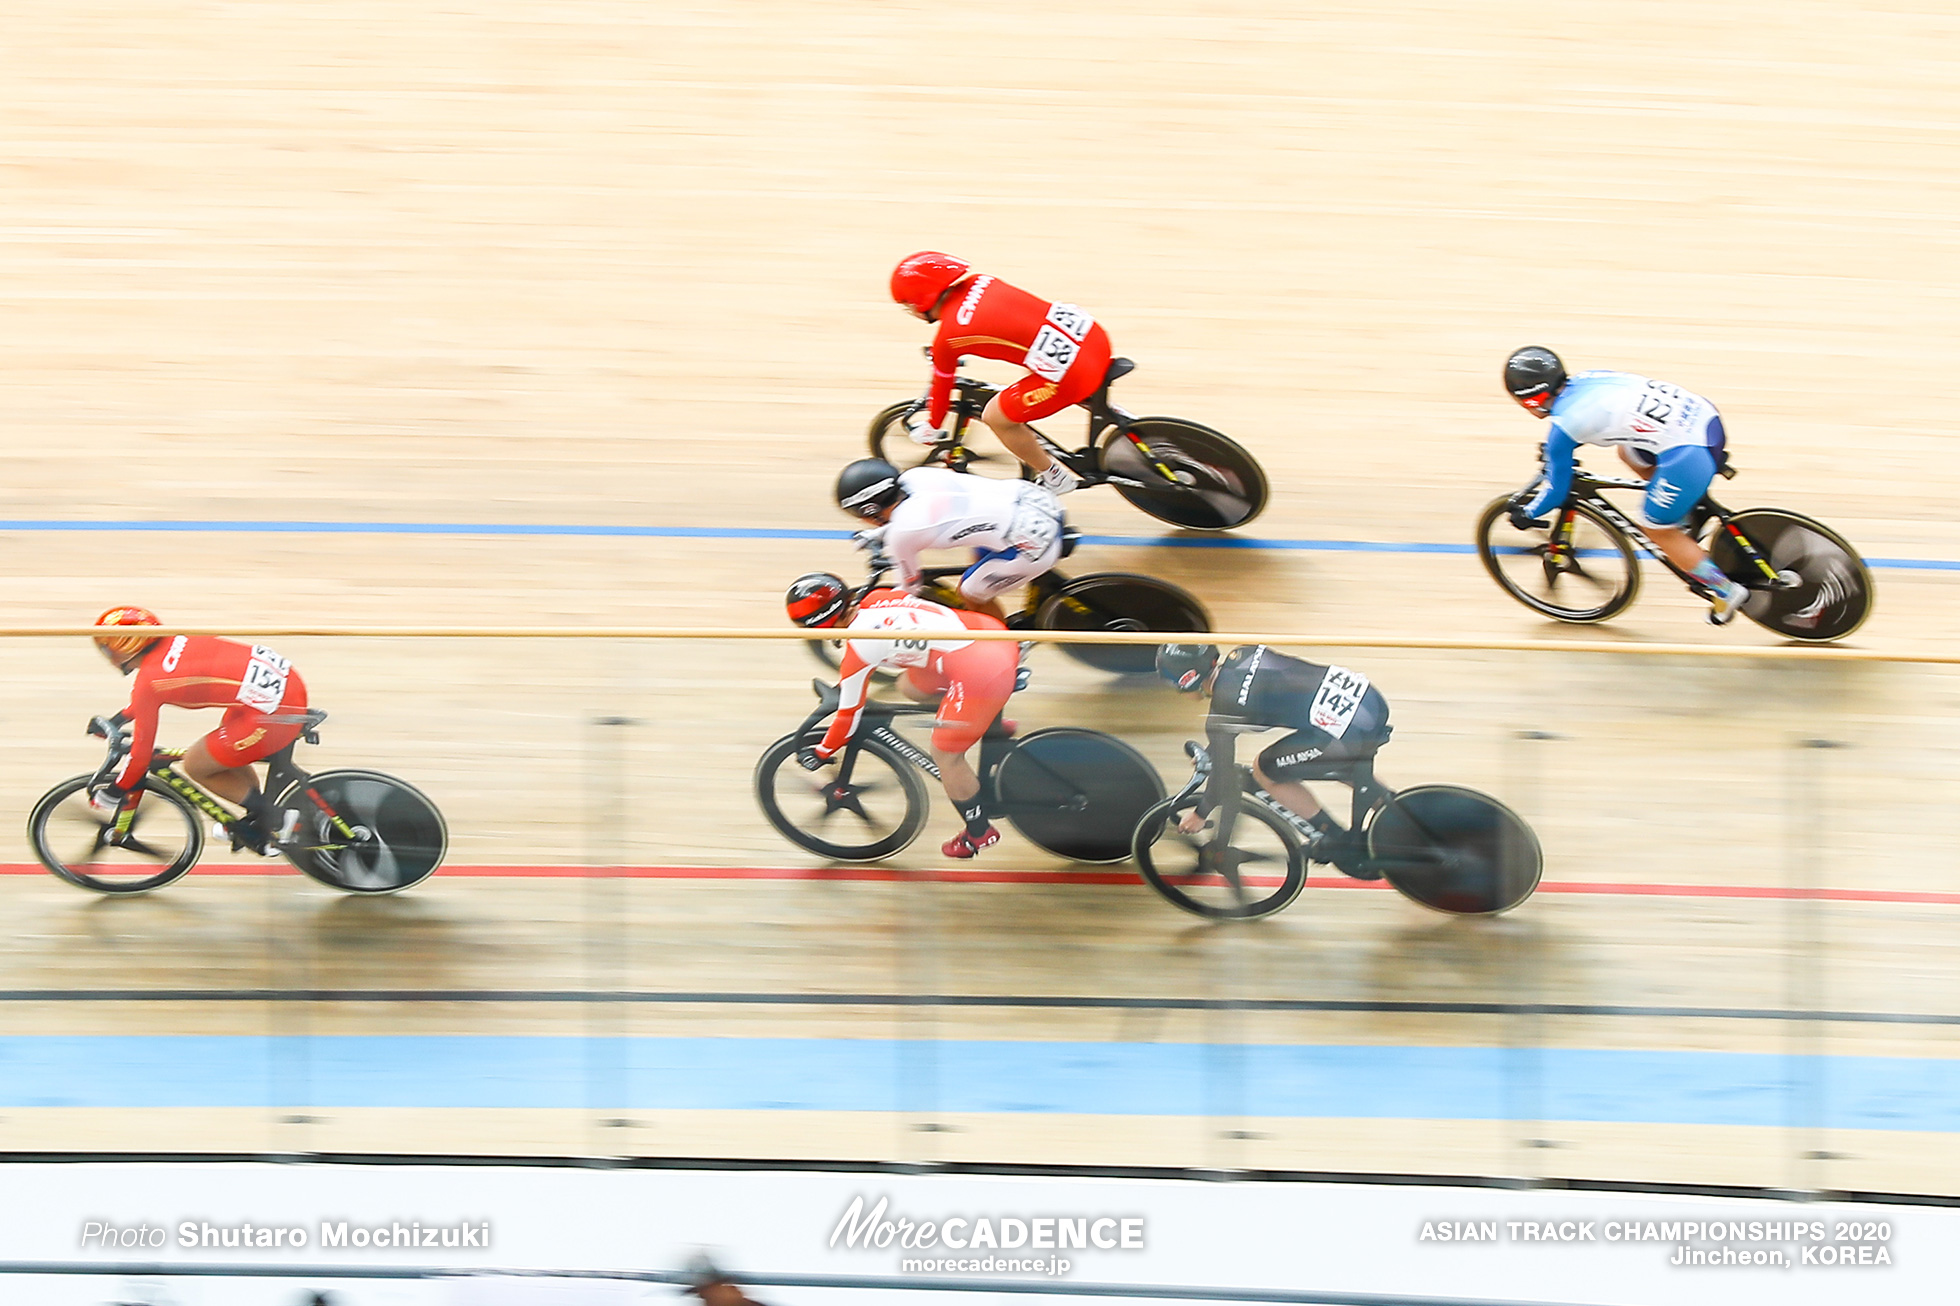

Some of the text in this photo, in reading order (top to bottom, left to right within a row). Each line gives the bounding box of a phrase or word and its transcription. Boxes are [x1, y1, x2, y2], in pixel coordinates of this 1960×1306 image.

[1037, 331, 1073, 365] 158
[1636, 394, 1672, 424] 122
[1318, 686, 1354, 717] 147
[1276, 747, 1323, 768] MALAYSIA
